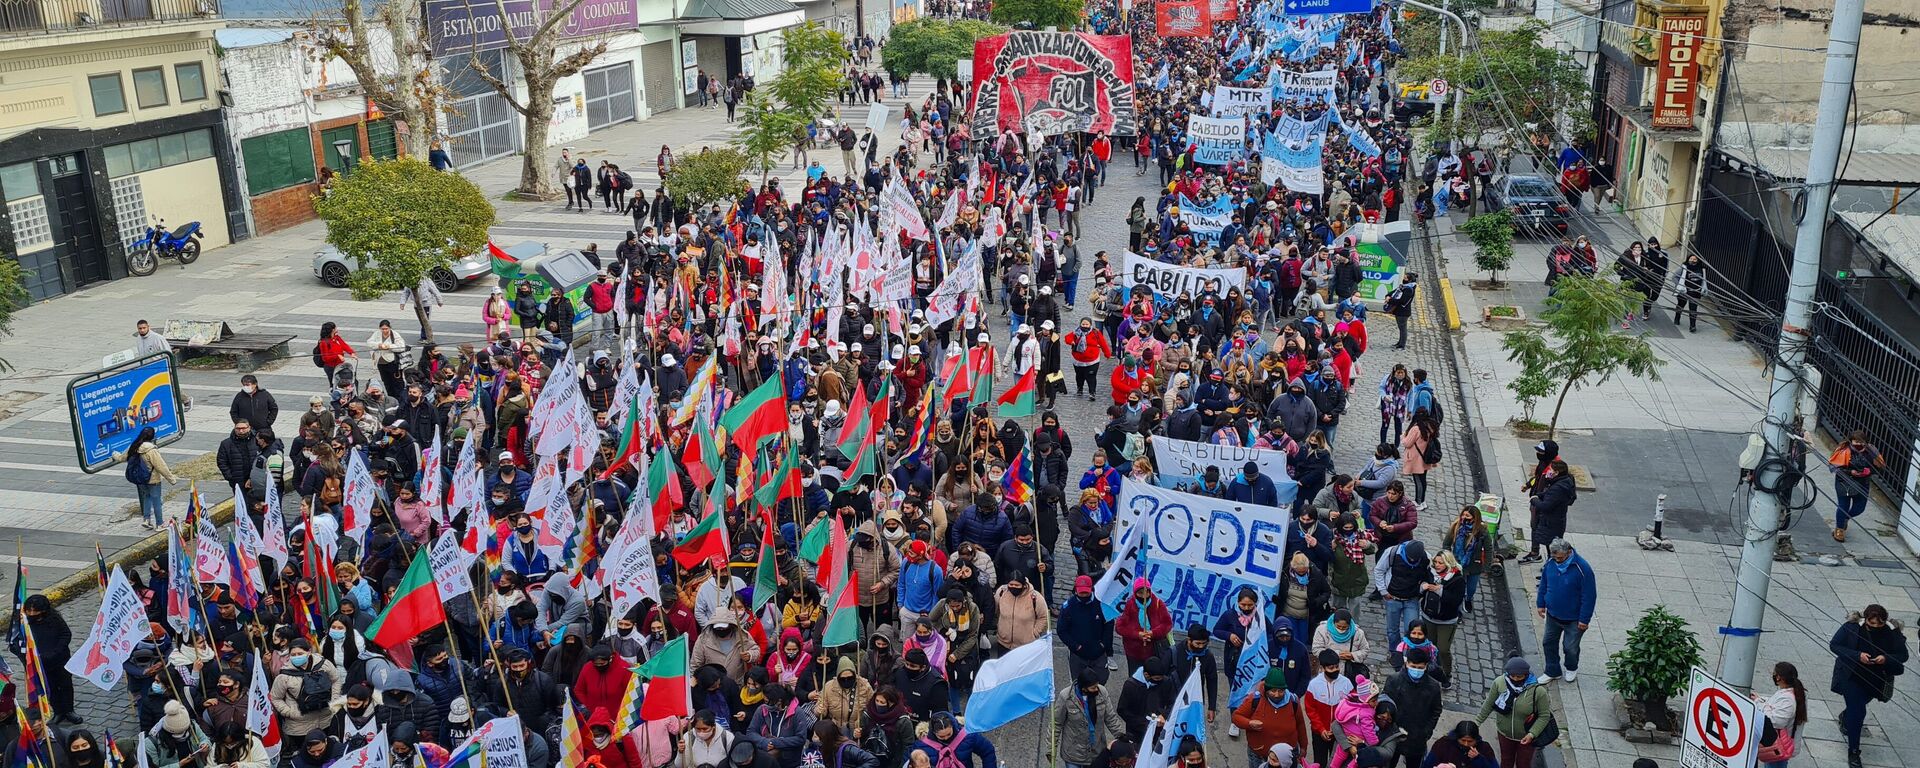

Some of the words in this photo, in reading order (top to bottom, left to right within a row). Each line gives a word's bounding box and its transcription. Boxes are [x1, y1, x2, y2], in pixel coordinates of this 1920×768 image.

[583, 1, 630, 20] COLONIAL
[1665, 19, 1702, 31] TANGO
[1664, 31, 1694, 108] HOTEL
[1050, 76, 1087, 110] FOL
[1229, 89, 1263, 102] MTR
[1108, 84, 1136, 136] LUCHA
[1660, 109, 1687, 117] FAMILIAS
[1192, 121, 1240, 136] CABILDO
[1654, 117, 1690, 125] PASAJEROS
[80, 384, 117, 401] Llegamos
[117, 379, 131, 389] con
[82, 401, 94, 409] las
[94, 391, 124, 405] mejores
[1206, 510, 1282, 579] DE
